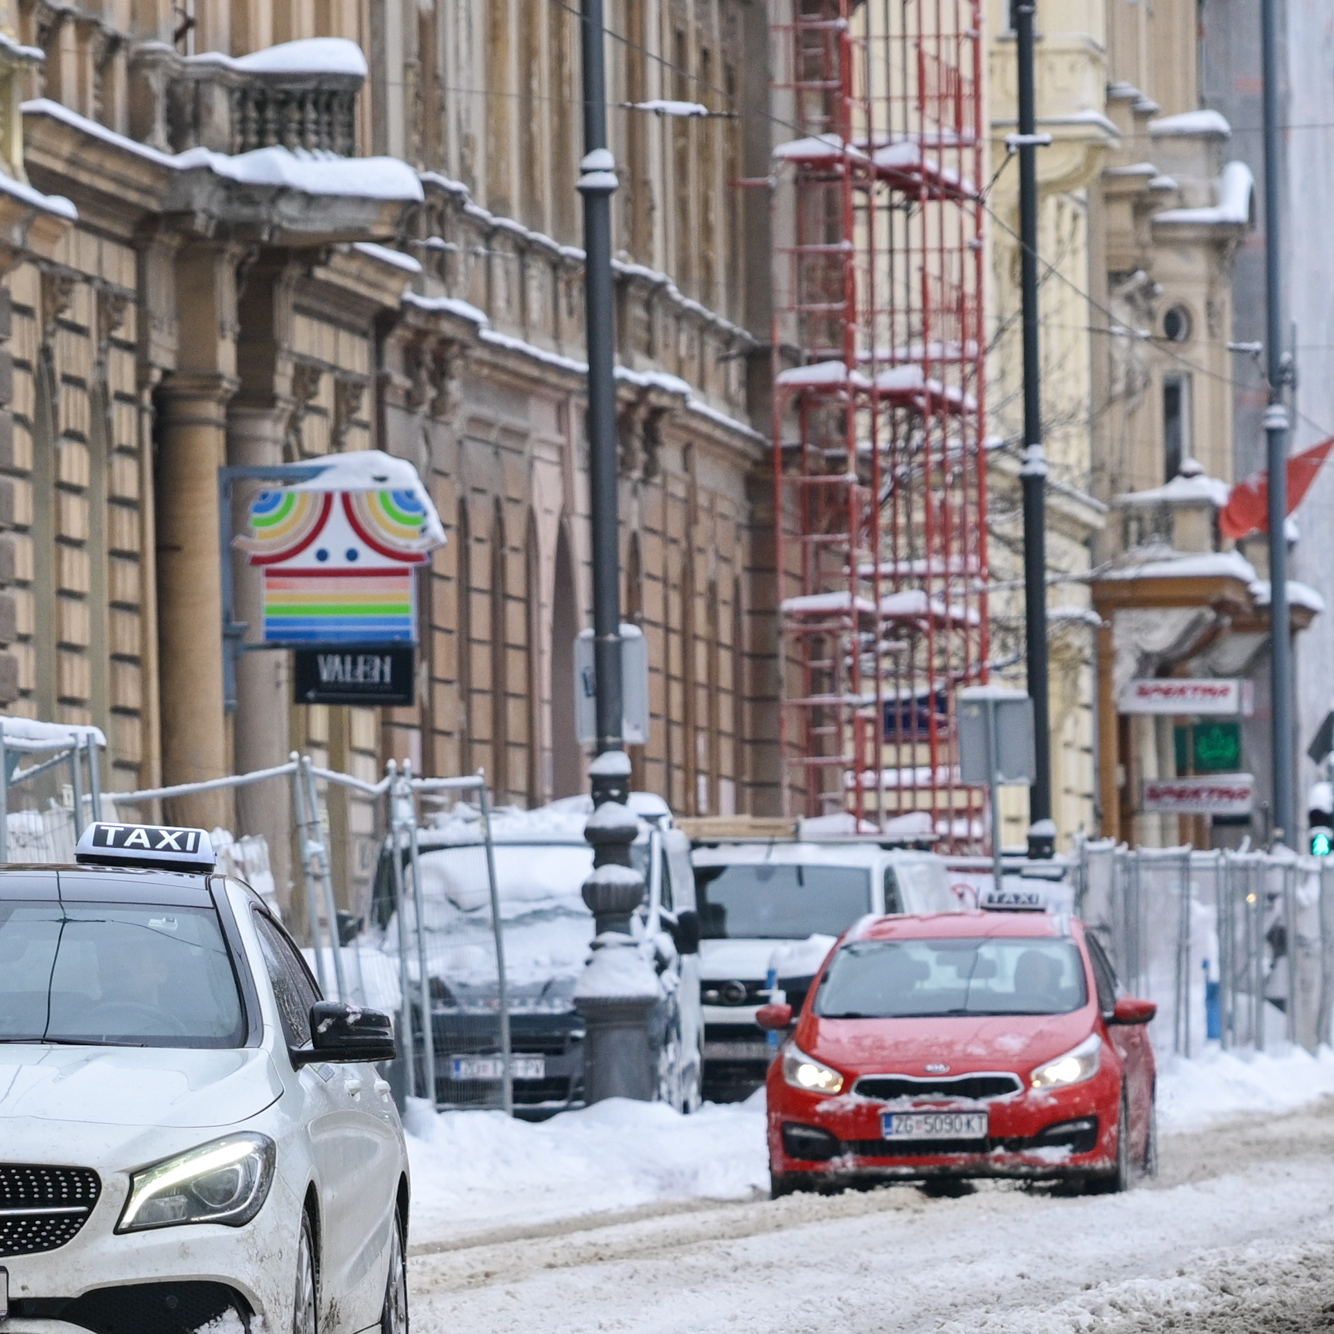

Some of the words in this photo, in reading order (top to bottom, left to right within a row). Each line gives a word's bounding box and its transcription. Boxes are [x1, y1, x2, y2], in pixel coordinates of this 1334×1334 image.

[100, 825, 196, 852] TAXI
[986, 893, 1040, 904] TAXI
[895, 1114, 914, 1134] ZG
